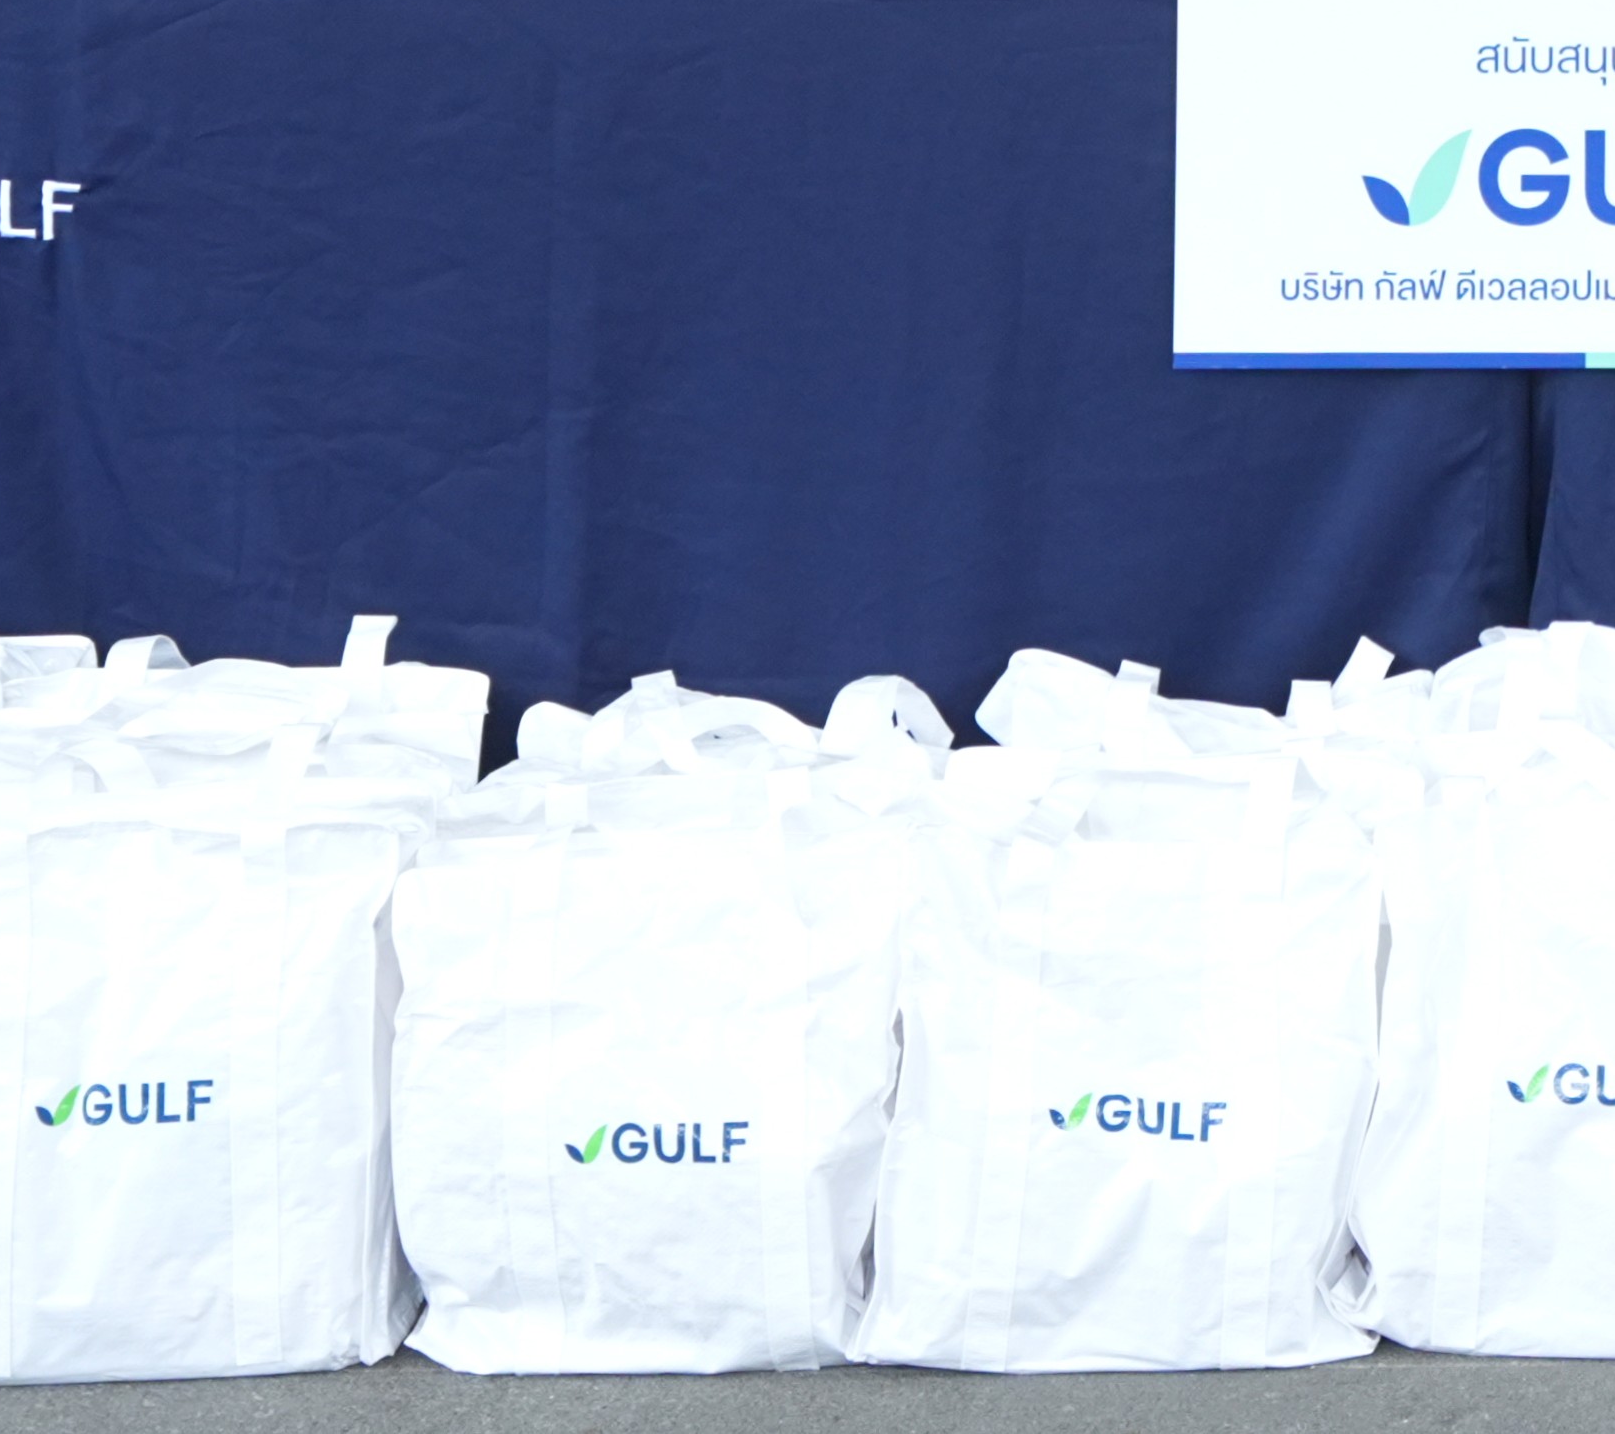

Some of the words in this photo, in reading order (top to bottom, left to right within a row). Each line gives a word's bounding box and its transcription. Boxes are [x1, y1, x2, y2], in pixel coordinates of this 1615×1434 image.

[1279, 270, 1364, 301] บริษัท
[1374, 269, 1447, 301] กัลฟ์
[81, 1077, 215, 1127] GULF
[1095, 1093, 1228, 1143] GULF
[610, 1120, 750, 1165] GULF
